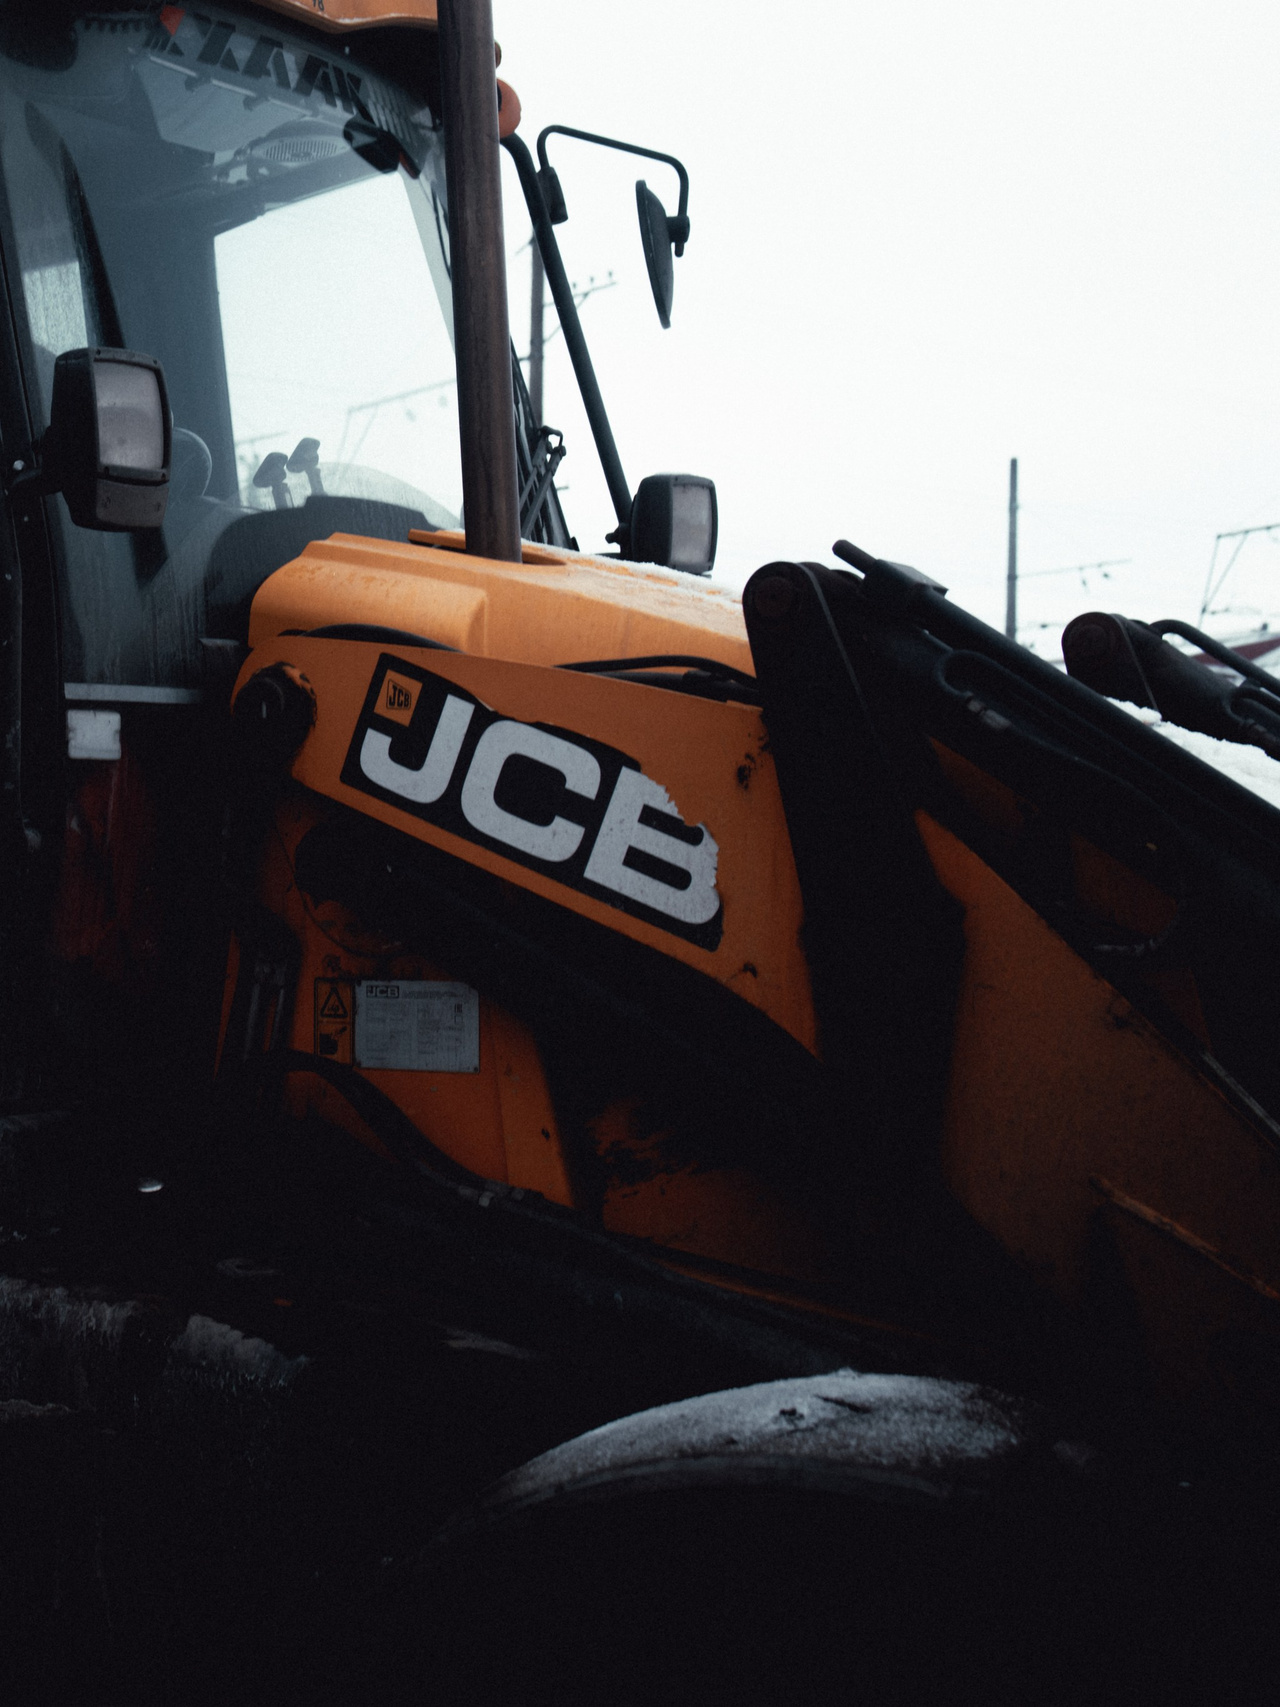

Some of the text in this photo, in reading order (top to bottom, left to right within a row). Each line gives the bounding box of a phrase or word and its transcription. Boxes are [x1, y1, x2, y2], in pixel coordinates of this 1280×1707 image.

[387, 681, 412, 710] JCB
[359, 692, 721, 925] JCB
[366, 985, 400, 999] JCB
